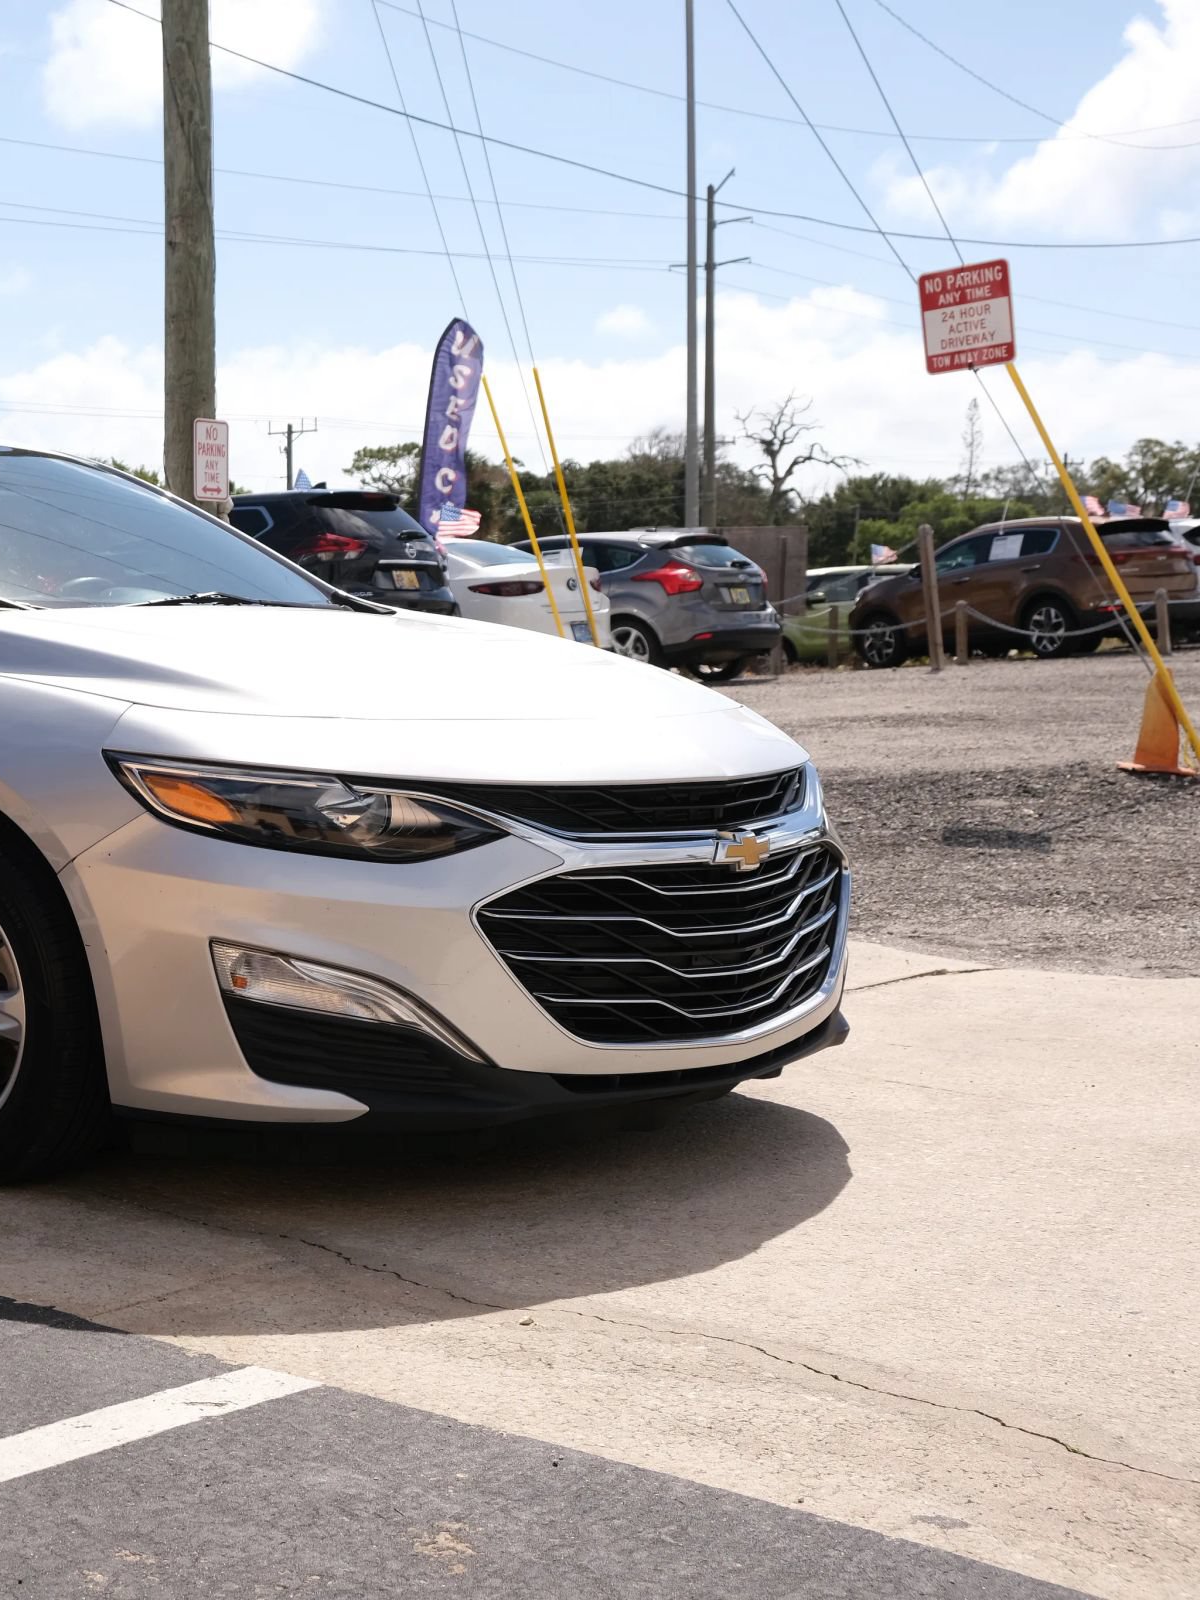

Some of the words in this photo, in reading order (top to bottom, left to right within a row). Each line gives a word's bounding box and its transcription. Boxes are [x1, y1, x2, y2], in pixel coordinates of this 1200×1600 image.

[924, 278, 942, 294] NO
[946, 266, 1003, 289] PARKING
[938, 291, 962, 306] ANY
[965, 285, 992, 300] TIME
[941, 310, 955, 323] 24
[960, 304, 991, 319] HOUR
[948, 318, 987, 335] ACTIVE
[940, 331, 996, 350] DRIVEWAY
[932, 355, 952, 369] TOW
[954, 350, 979, 366] AWAY
[983, 345, 1008, 360] ZONE
[205, 426, 218, 441] NO
[197, 442, 226, 458] PARKING
[205, 459, 219, 471] ANY
[204, 471, 220, 483] TIME
